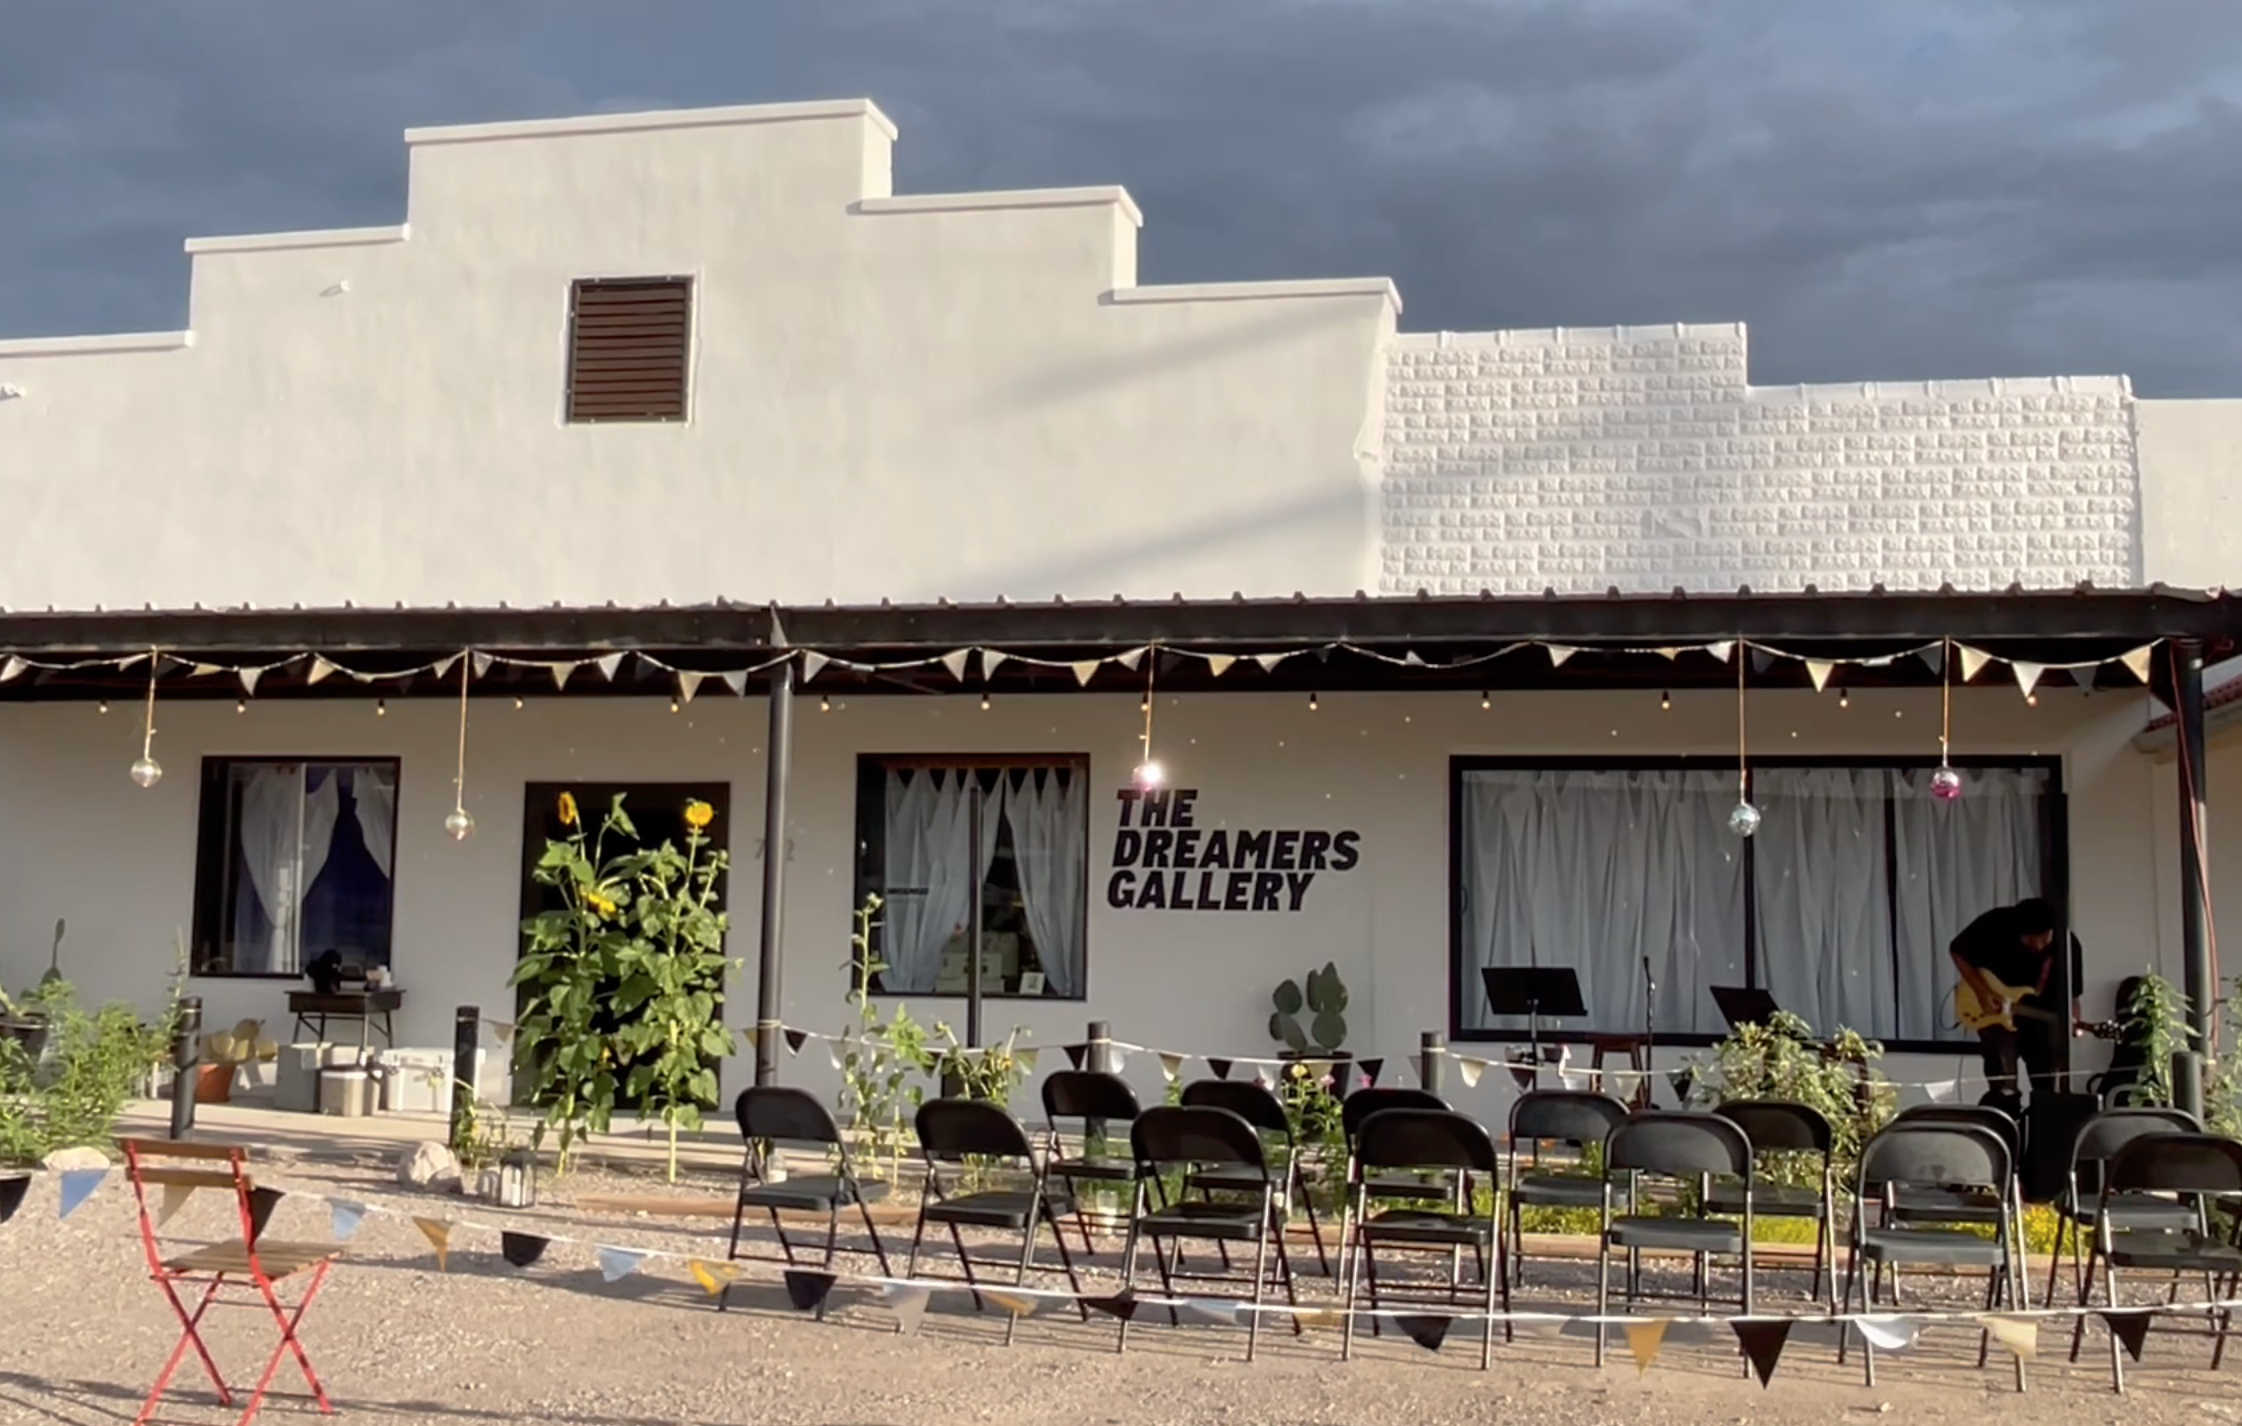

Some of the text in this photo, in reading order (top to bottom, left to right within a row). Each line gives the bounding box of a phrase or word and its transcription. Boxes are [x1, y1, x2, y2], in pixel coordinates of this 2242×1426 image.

[1116, 788, 1199, 829] THE
[752, 837, 796, 862] 72
[1111, 828, 1361, 872] DREAMERS
[1107, 869, 1316, 912] GALLERY
